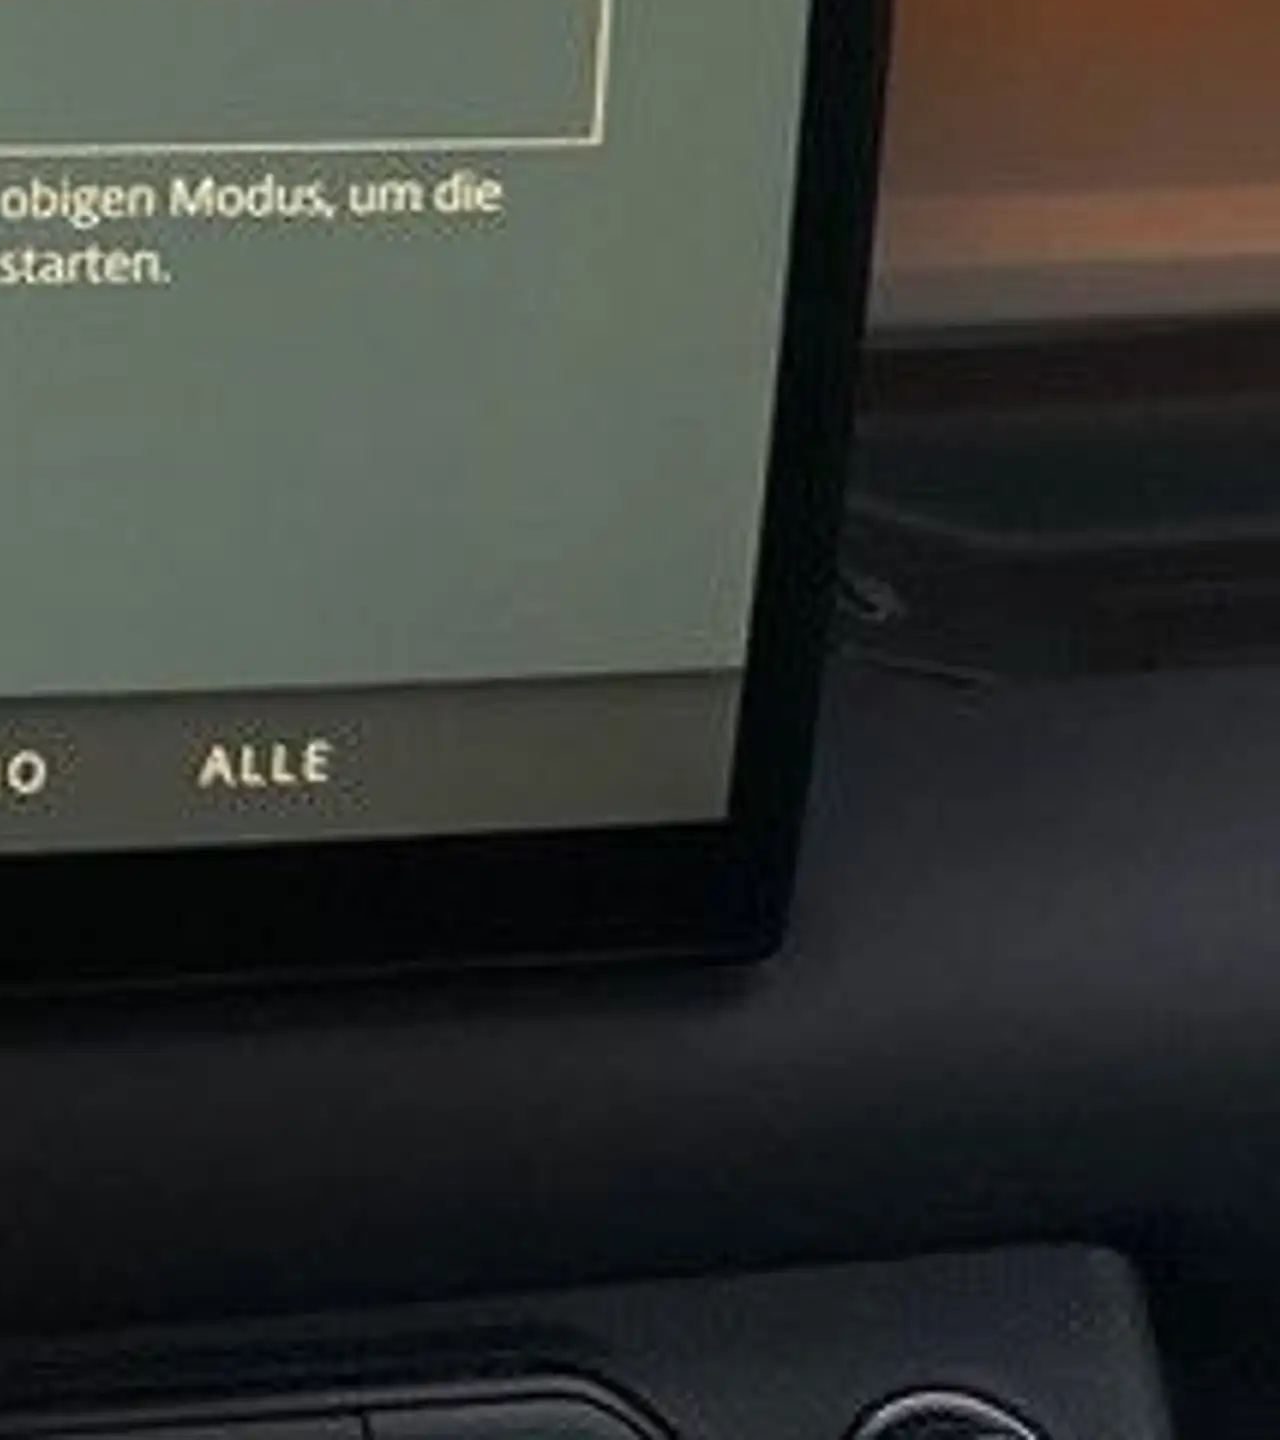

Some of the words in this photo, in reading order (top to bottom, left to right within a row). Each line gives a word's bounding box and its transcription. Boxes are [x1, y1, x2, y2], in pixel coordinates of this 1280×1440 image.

[0, 177, 157, 231] obigen
[168, 172, 338, 226] Modus,
[348, 180, 425, 217] um
[432, 171, 503, 214] die
[198, 739, 333, 787] ALLE
